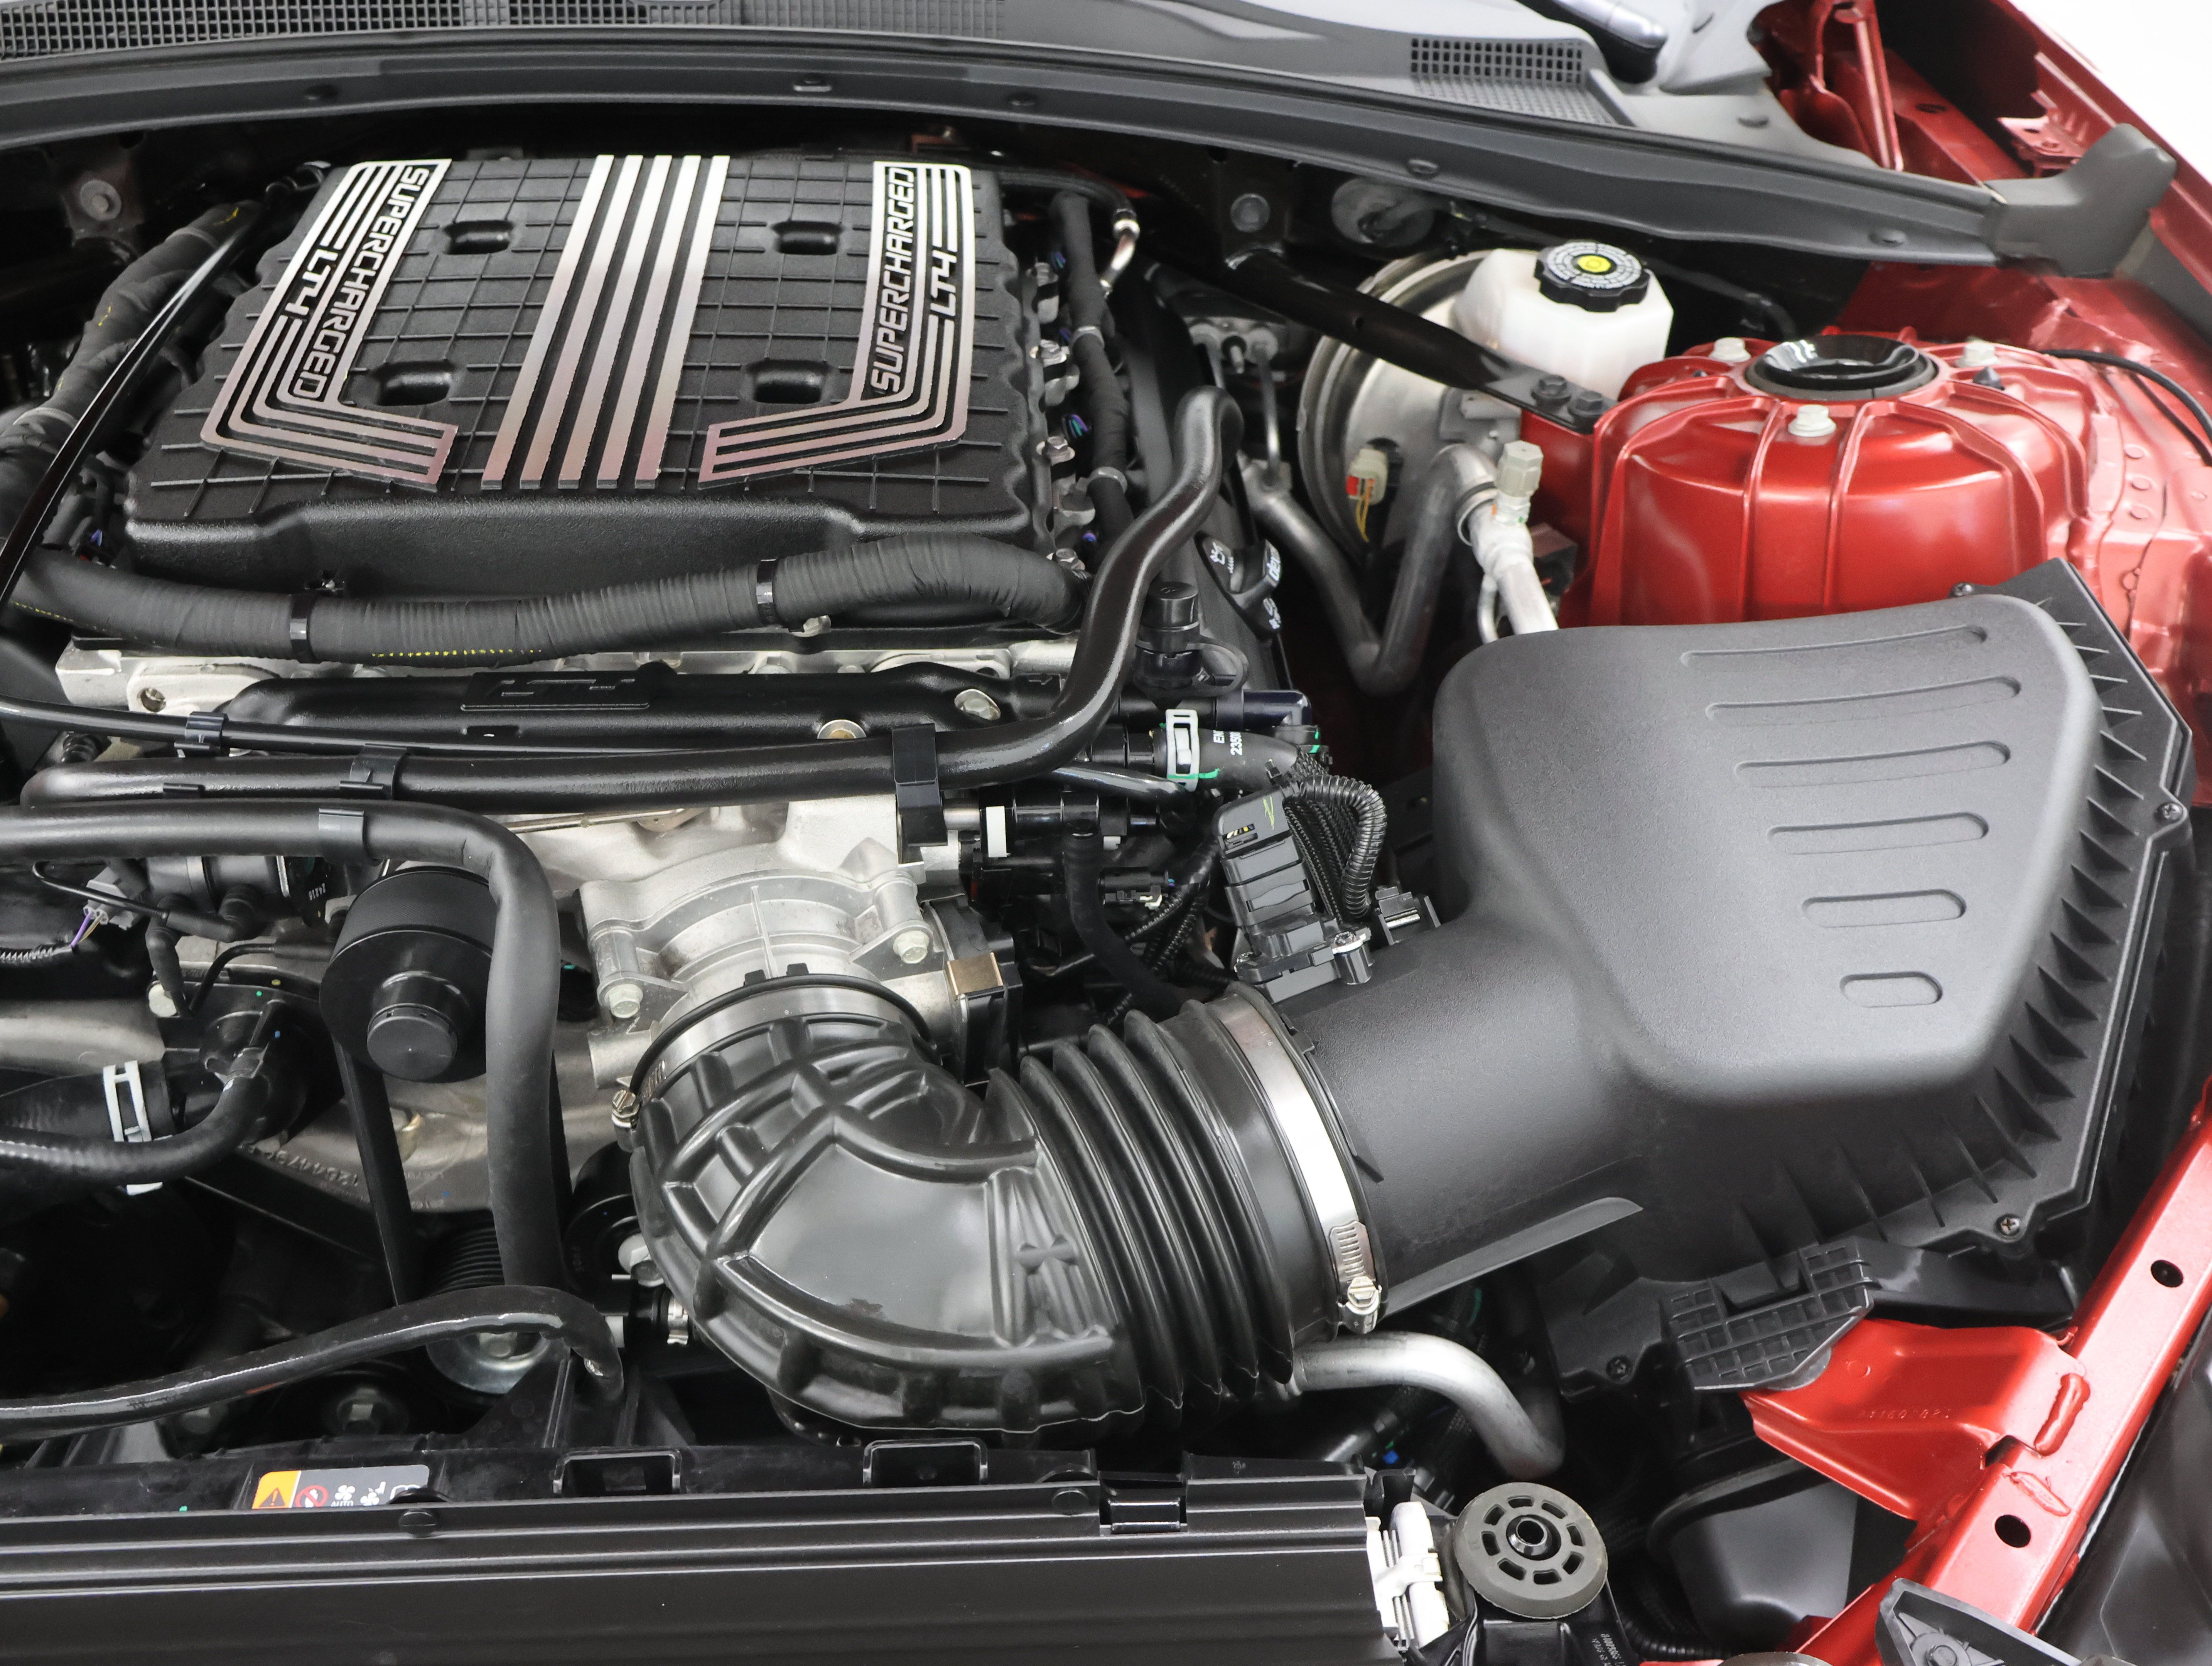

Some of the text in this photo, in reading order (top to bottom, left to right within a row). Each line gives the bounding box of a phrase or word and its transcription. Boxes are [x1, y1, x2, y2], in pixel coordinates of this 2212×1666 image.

[285, 249, 338, 315] LT4
[293, 167, 429, 399] SUPERCHARGED
[871, 167, 914, 392] SUPERCHARGED
[930, 250, 957, 316] LT4
